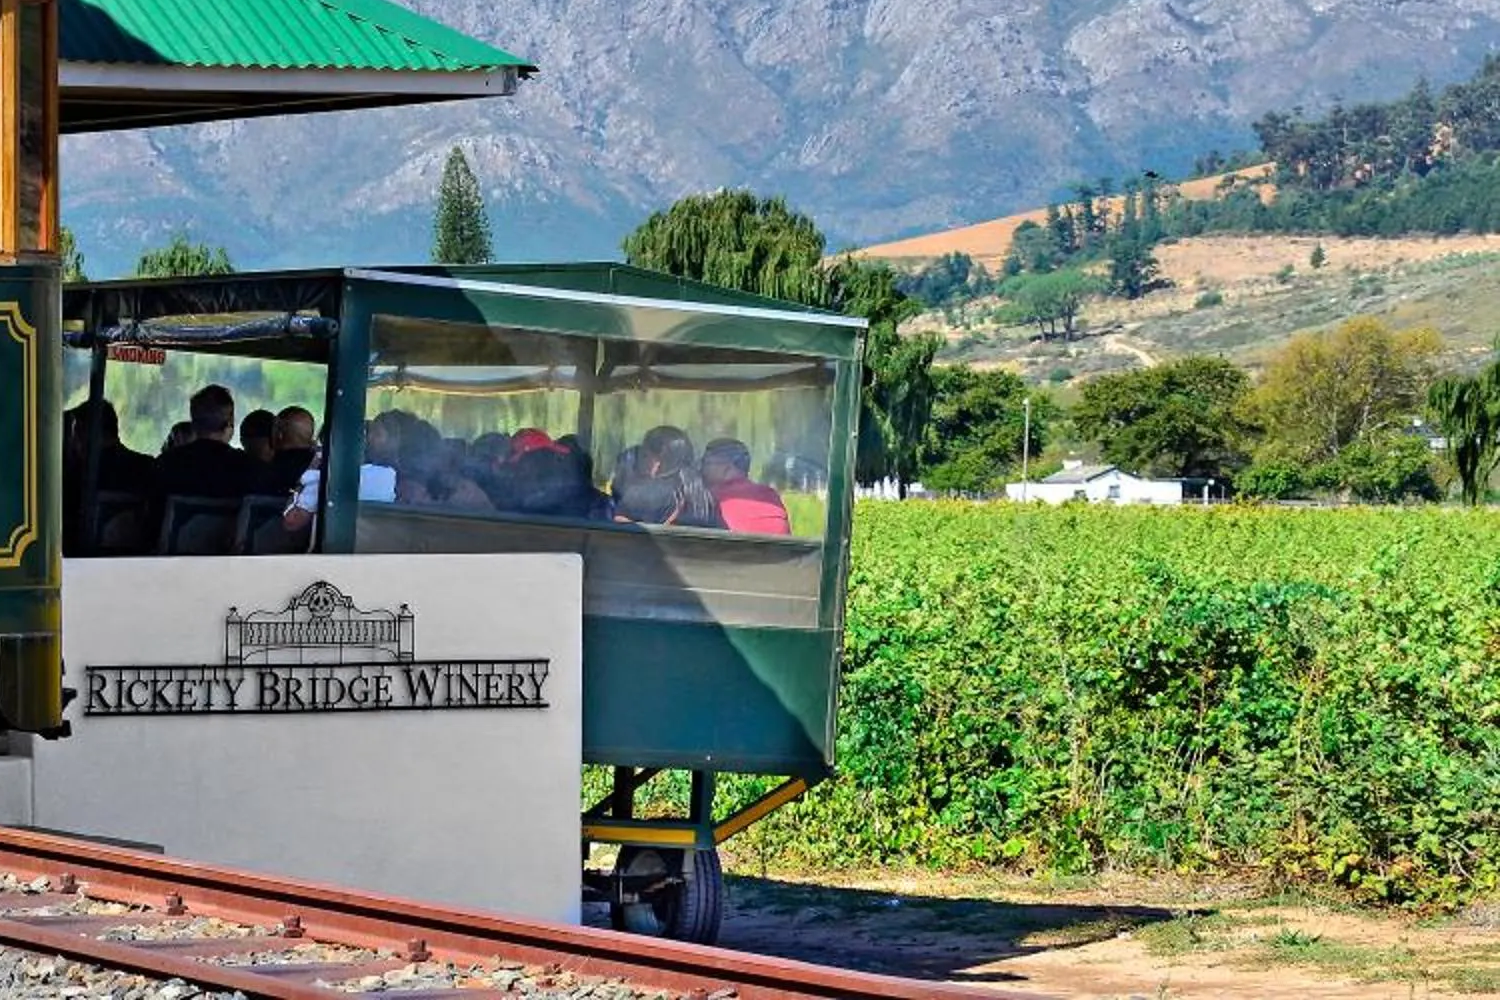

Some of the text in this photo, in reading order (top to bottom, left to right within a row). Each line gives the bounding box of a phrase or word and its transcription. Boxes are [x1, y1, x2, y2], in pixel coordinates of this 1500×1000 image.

[86, 666, 550, 712] RICKETY BRIDGE WINERY
